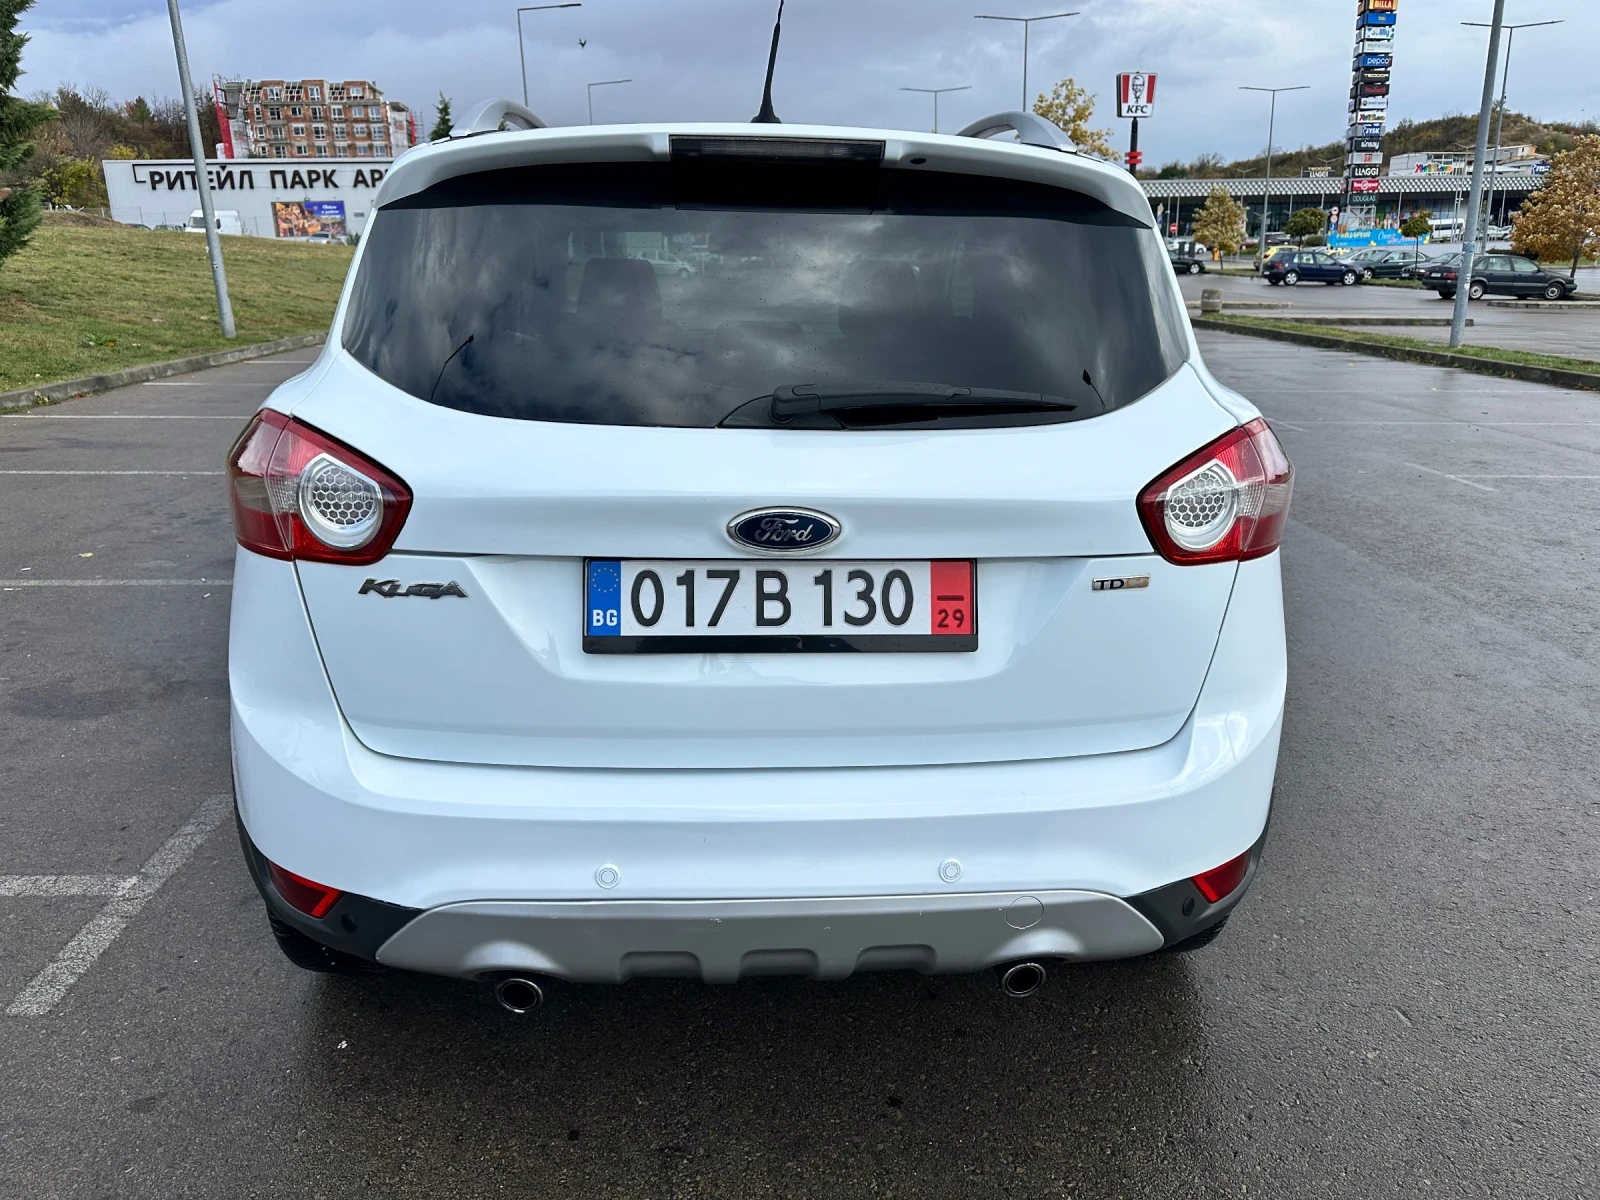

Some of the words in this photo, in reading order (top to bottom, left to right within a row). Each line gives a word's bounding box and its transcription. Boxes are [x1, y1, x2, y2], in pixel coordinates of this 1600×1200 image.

[1367, 57, 1389, 65] pepco
[1126, 105, 1148, 114] KFC
[1361, 140, 1380, 149] sinsay
[149, 165, 254, 190] РИТЕЙЛ
[269, 169, 339, 189] ПАРК
[353, 168, 388, 188] АР
[754, 517, 813, 541] Ford
[630, 569, 741, 628] 017
[755, 570, 793, 627] B
[813, 569, 914, 628] 130
[592, 609, 618, 627] BG
[936, 608, 965, 629] 29
